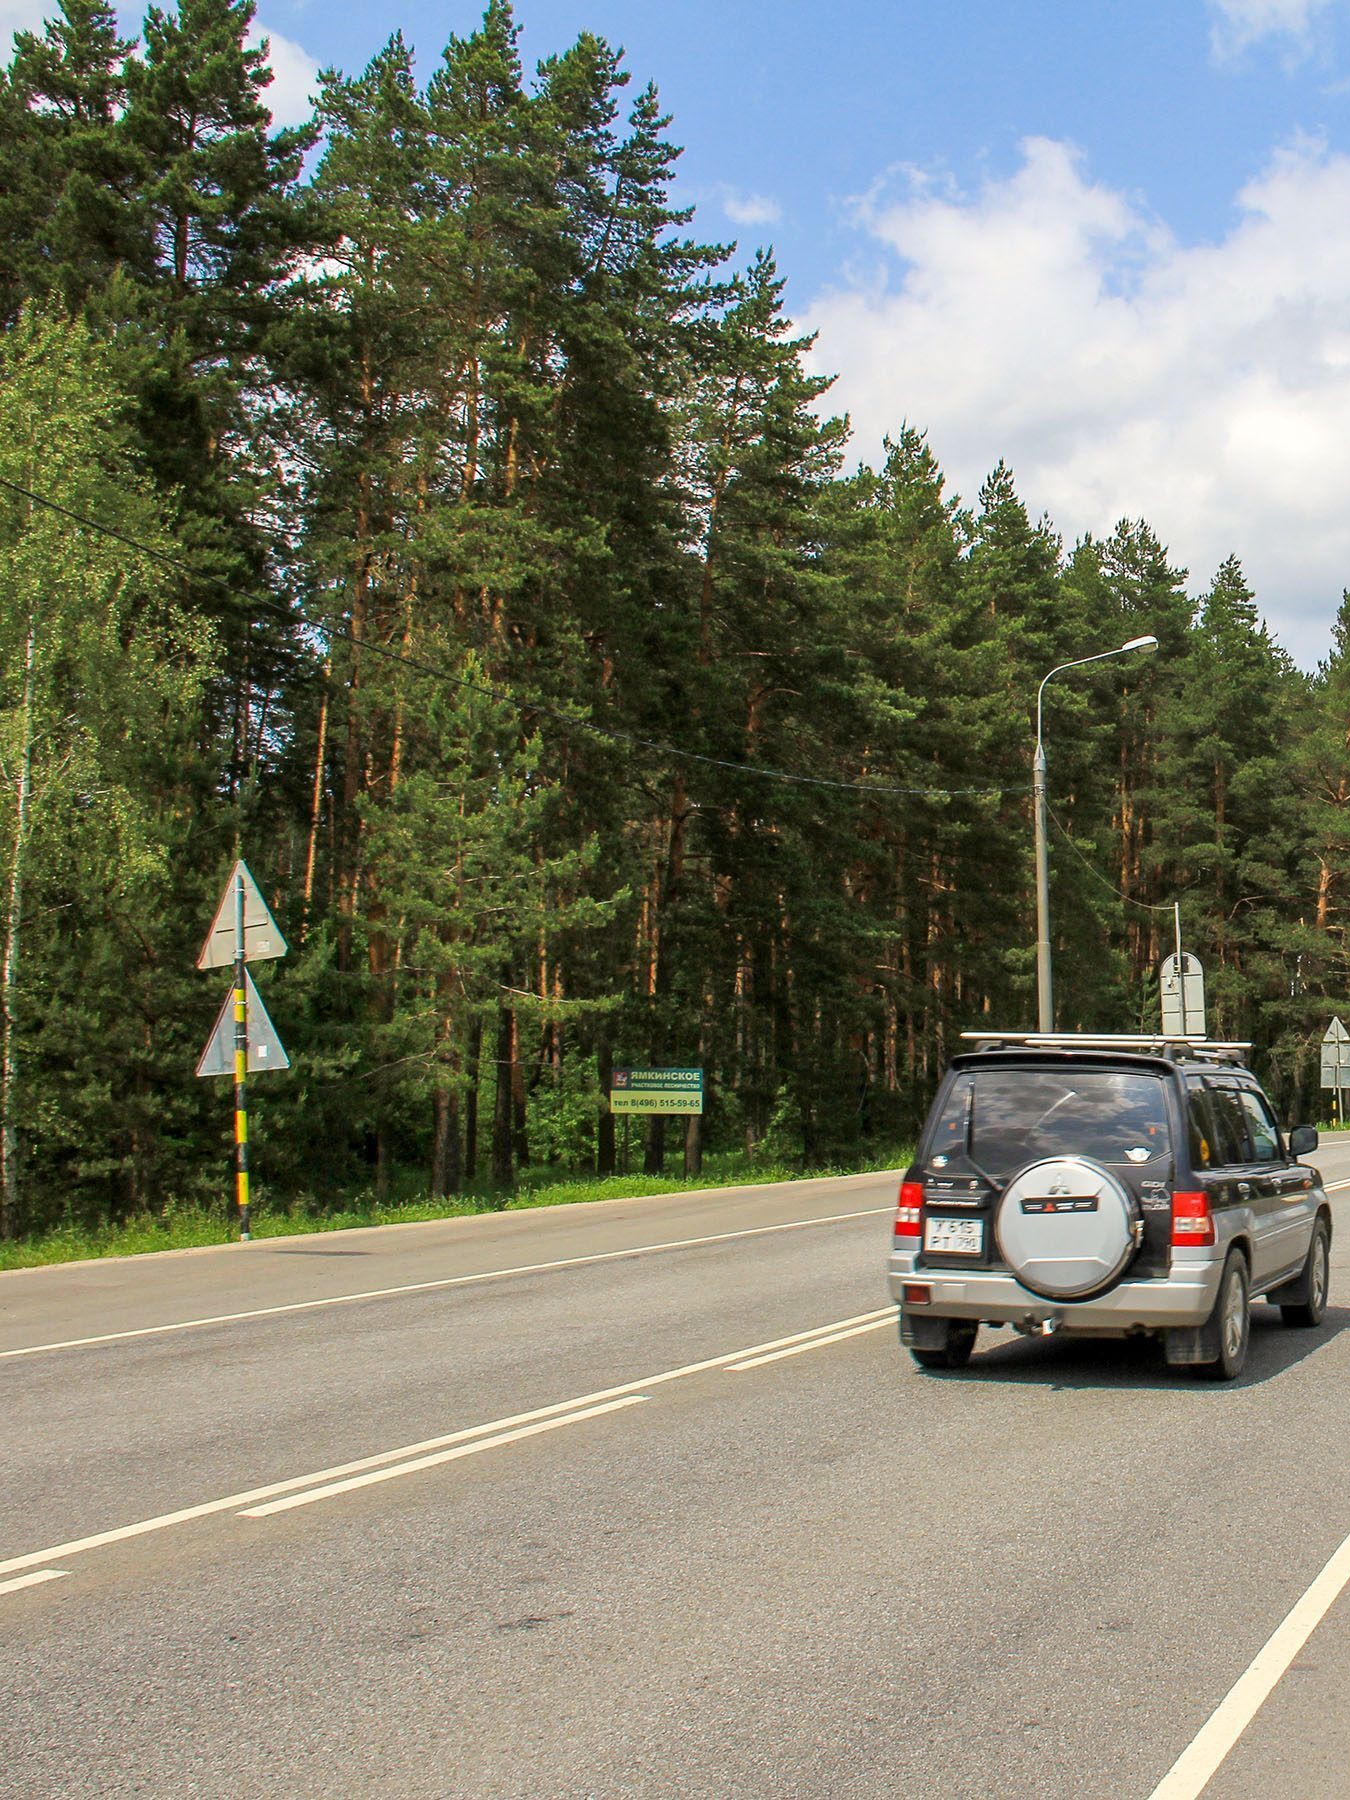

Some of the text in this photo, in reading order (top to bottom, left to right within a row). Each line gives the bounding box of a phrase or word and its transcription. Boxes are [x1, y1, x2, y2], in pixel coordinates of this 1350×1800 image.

[631, 1071, 700, 1080] ЯМКИНСКОЕ
[631, 1099, 657, 1108] 8(496)
[660, 1099, 700, 1107] 515-59-65
